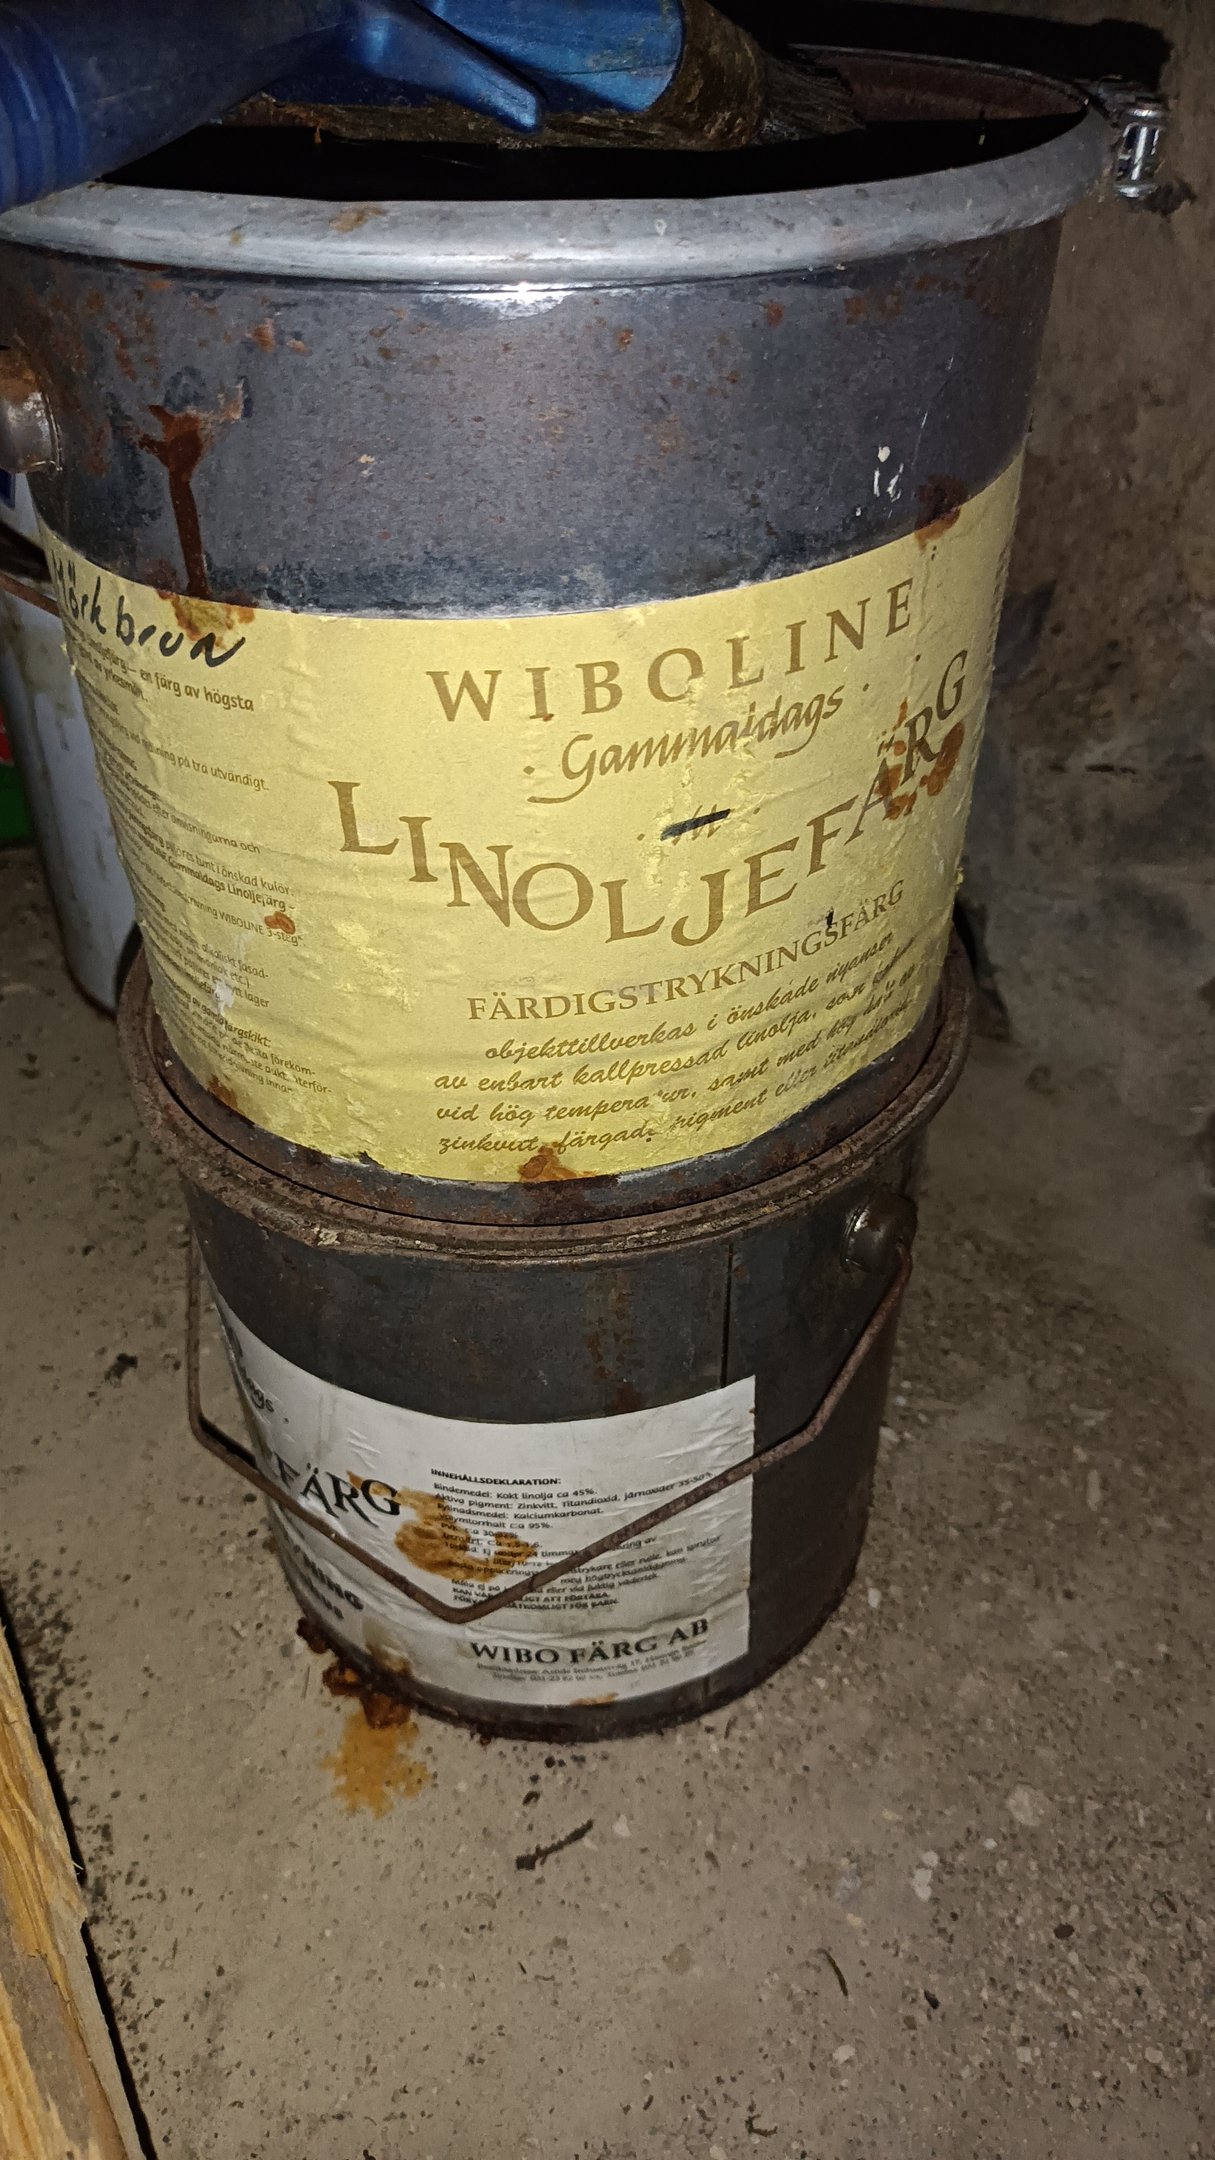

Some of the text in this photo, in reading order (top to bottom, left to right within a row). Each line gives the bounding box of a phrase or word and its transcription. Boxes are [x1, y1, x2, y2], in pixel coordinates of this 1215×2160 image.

[426, 577, 913, 722] WIBOLINE
[154, 671, 182, 697] färg
[184, 683, 200, 699] av
[203, 685, 255, 712] högsta
[528, 684, 845, 803] Gammaldags
[327, 650, 968, 947] LINOLJEFÄRG
[239, 841, 261, 855] och
[221, 863, 258, 887] önskad
[468, 879, 905, 1020] FÄRDIGSTRYKNINGSFÄRG
[245, 986, 269, 1009] lager
[434, 1075, 468, 1091] av
[478, 1070, 564, 1093] enbart
[572, 1039, 731, 1086] kallpressad
[736, 1007, 818, 1052] linolja,
[485, 1020, 697, 1065] objekttillverkas
[706, 1013, 719, 1032] i
[269, 1050, 316, 1077] förekom-
[436, 1103, 480, 1122] vid
[489, 1102, 536, 1128] hög
[545, 1088, 697, 1121] temperaur,
[707, 1057, 770, 1091] samt
[776, 1029, 825, 1067] med
[430, 1467, 562, 1486] INNEHÅLLSDEKLARATION:
[433, 1482, 493, 1499] Bindemedel:
[496, 1491, 518, 1500] Kokt
[521, 1491, 553, 1501] linolja
[556, 1490, 569, 1498] ca
[468, 1500, 513, 1510] pigment:
[517, 1501, 558, 1510] Zinkvitt,
[562, 1494, 620, 1508] Titandioxid,
[513, 1507, 605, 1520] Kalciumkarbonat.
[471, 1641, 560, 1665] WIBO
[569, 1635, 659, 1664] FÄRG
[667, 1617, 709, 1646] AB
